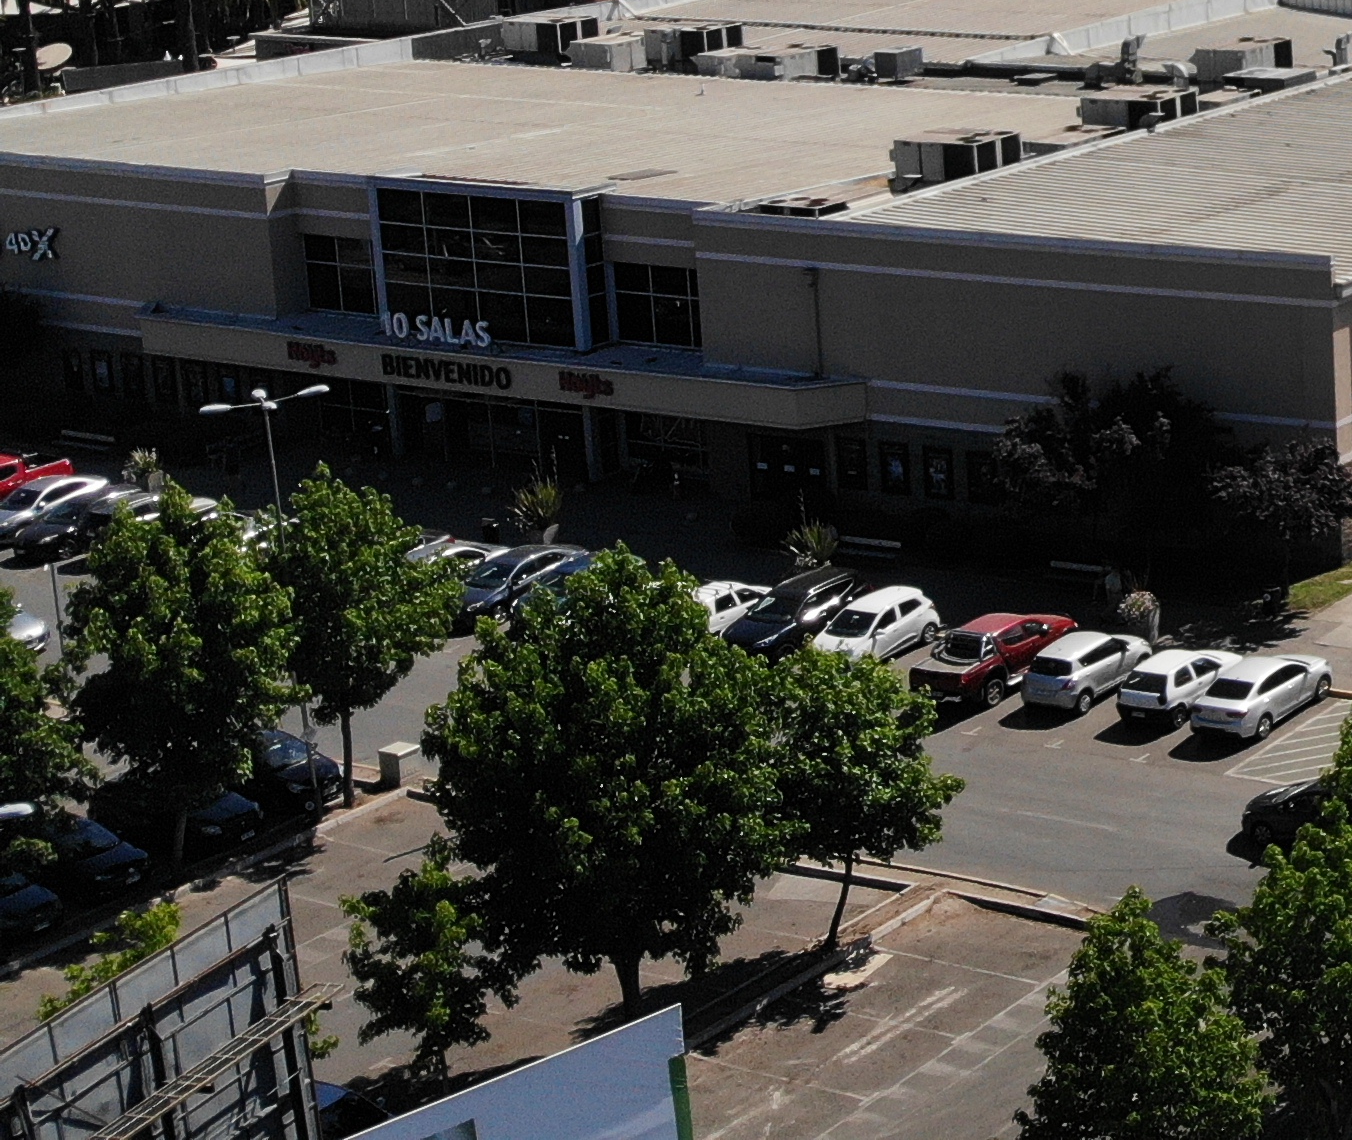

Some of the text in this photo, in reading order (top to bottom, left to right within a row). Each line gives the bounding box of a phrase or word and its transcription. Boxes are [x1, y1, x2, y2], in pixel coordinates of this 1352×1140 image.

[6, 228, 56, 260] 4DX
[383, 311, 491, 347] 10 SALAS
[381, 353, 512, 390] BIENVENIDO
